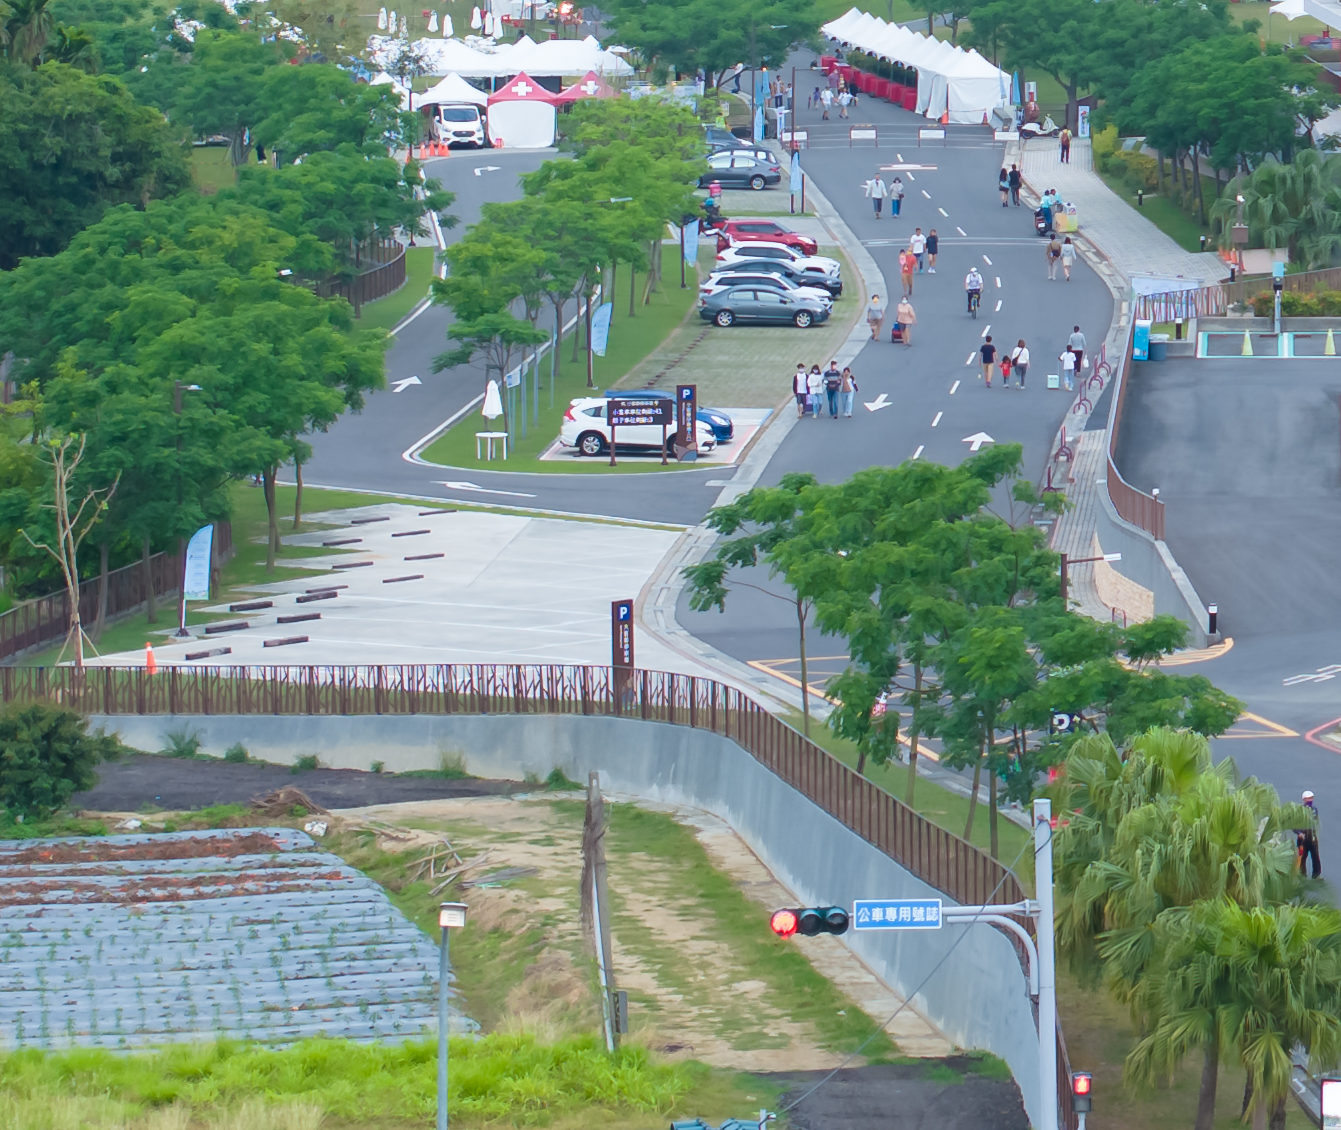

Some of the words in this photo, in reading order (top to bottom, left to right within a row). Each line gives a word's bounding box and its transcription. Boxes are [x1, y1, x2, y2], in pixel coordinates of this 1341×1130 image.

[682, 389, 691, 399] P
[857, 906, 939, 923] 公車專用號誌
